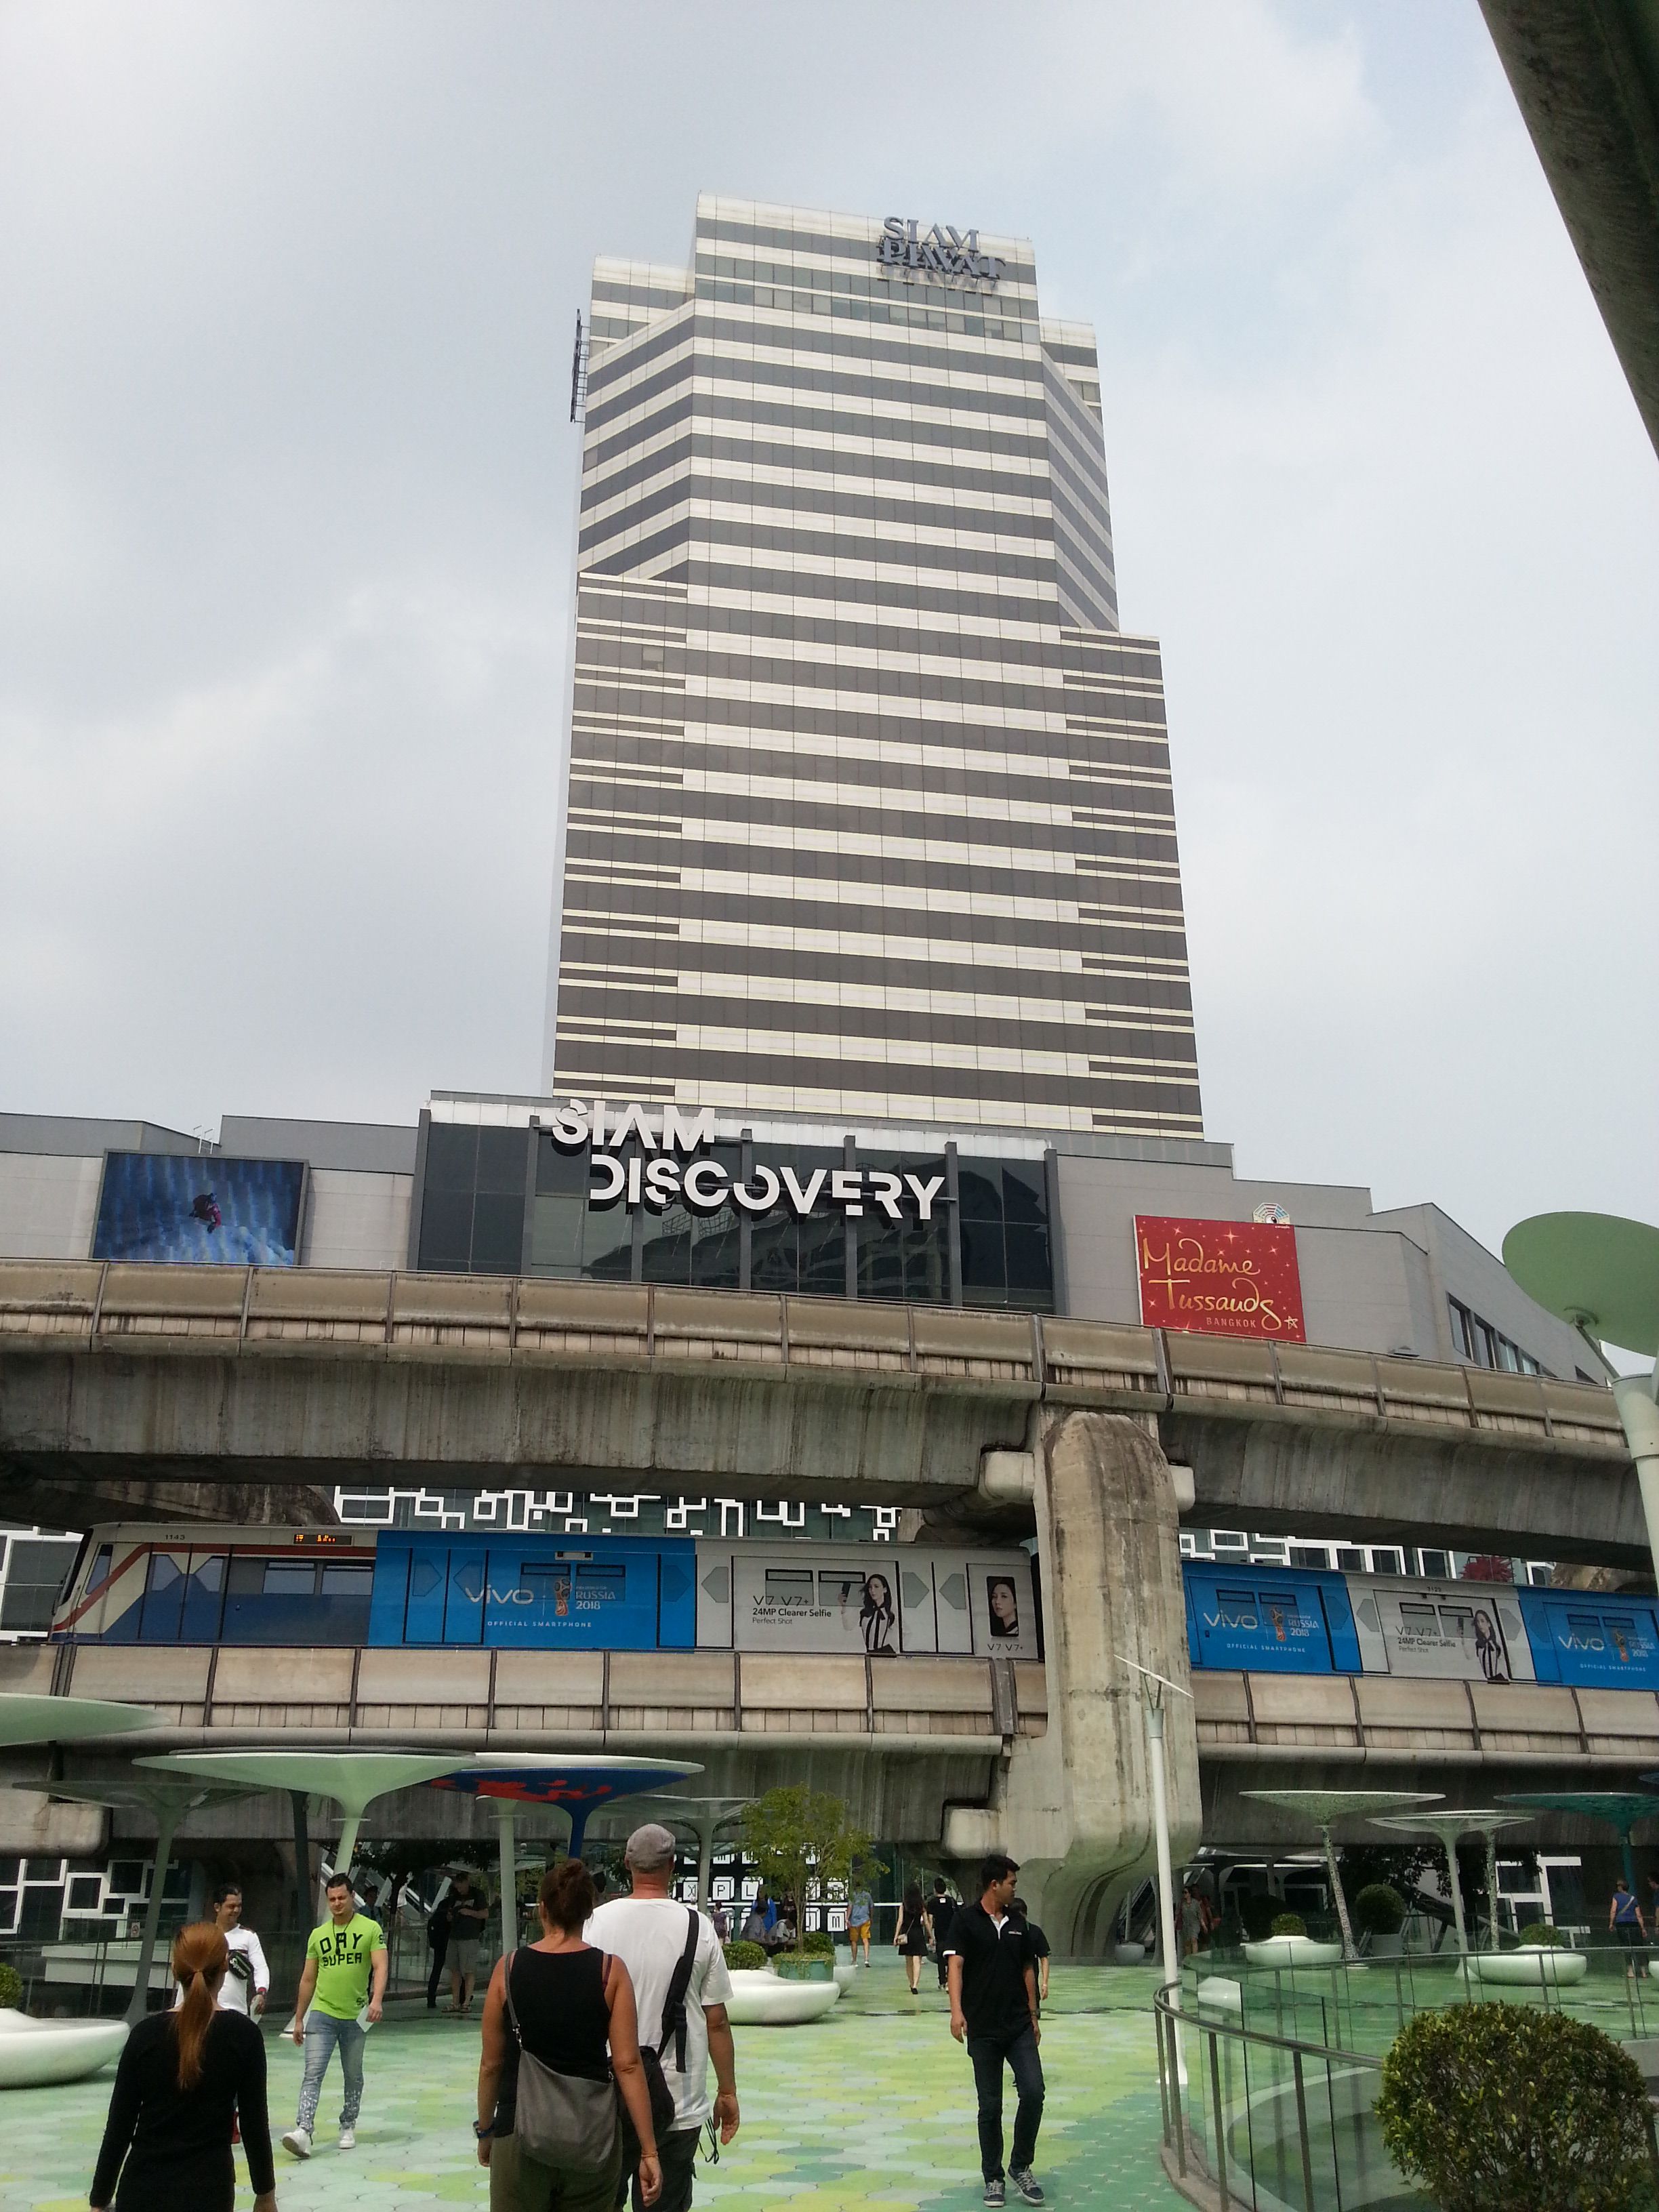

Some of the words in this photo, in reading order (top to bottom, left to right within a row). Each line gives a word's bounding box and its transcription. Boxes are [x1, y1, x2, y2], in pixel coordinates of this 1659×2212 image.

[884, 216, 979, 253] SIAM
[552, 1099, 715, 1151] SIAM
[590, 1153, 945, 1220] DISCOVERY
[1143, 1237, 1261, 1275] Madame
[1148, 1277, 1282, 1330] Tussauds
[1206, 1317, 1256, 1329] BANGKOK
[575, 1591, 616, 1599] RUSSIA
[753, 1595, 774, 1605] V7
[781, 1596, 808, 1606] V7+
[575, 1601, 601, 1610] 2018
[753, 1607, 776, 1616] 24MP
[778, 1608, 808, 1616] Clearer
[809, 1609, 832, 1617] Selfie
[1288, 1619, 1319, 1629] RUSSIA
[1290, 1628, 1310, 1637] 2018
[322, 1952, 363, 1967] SUPER
